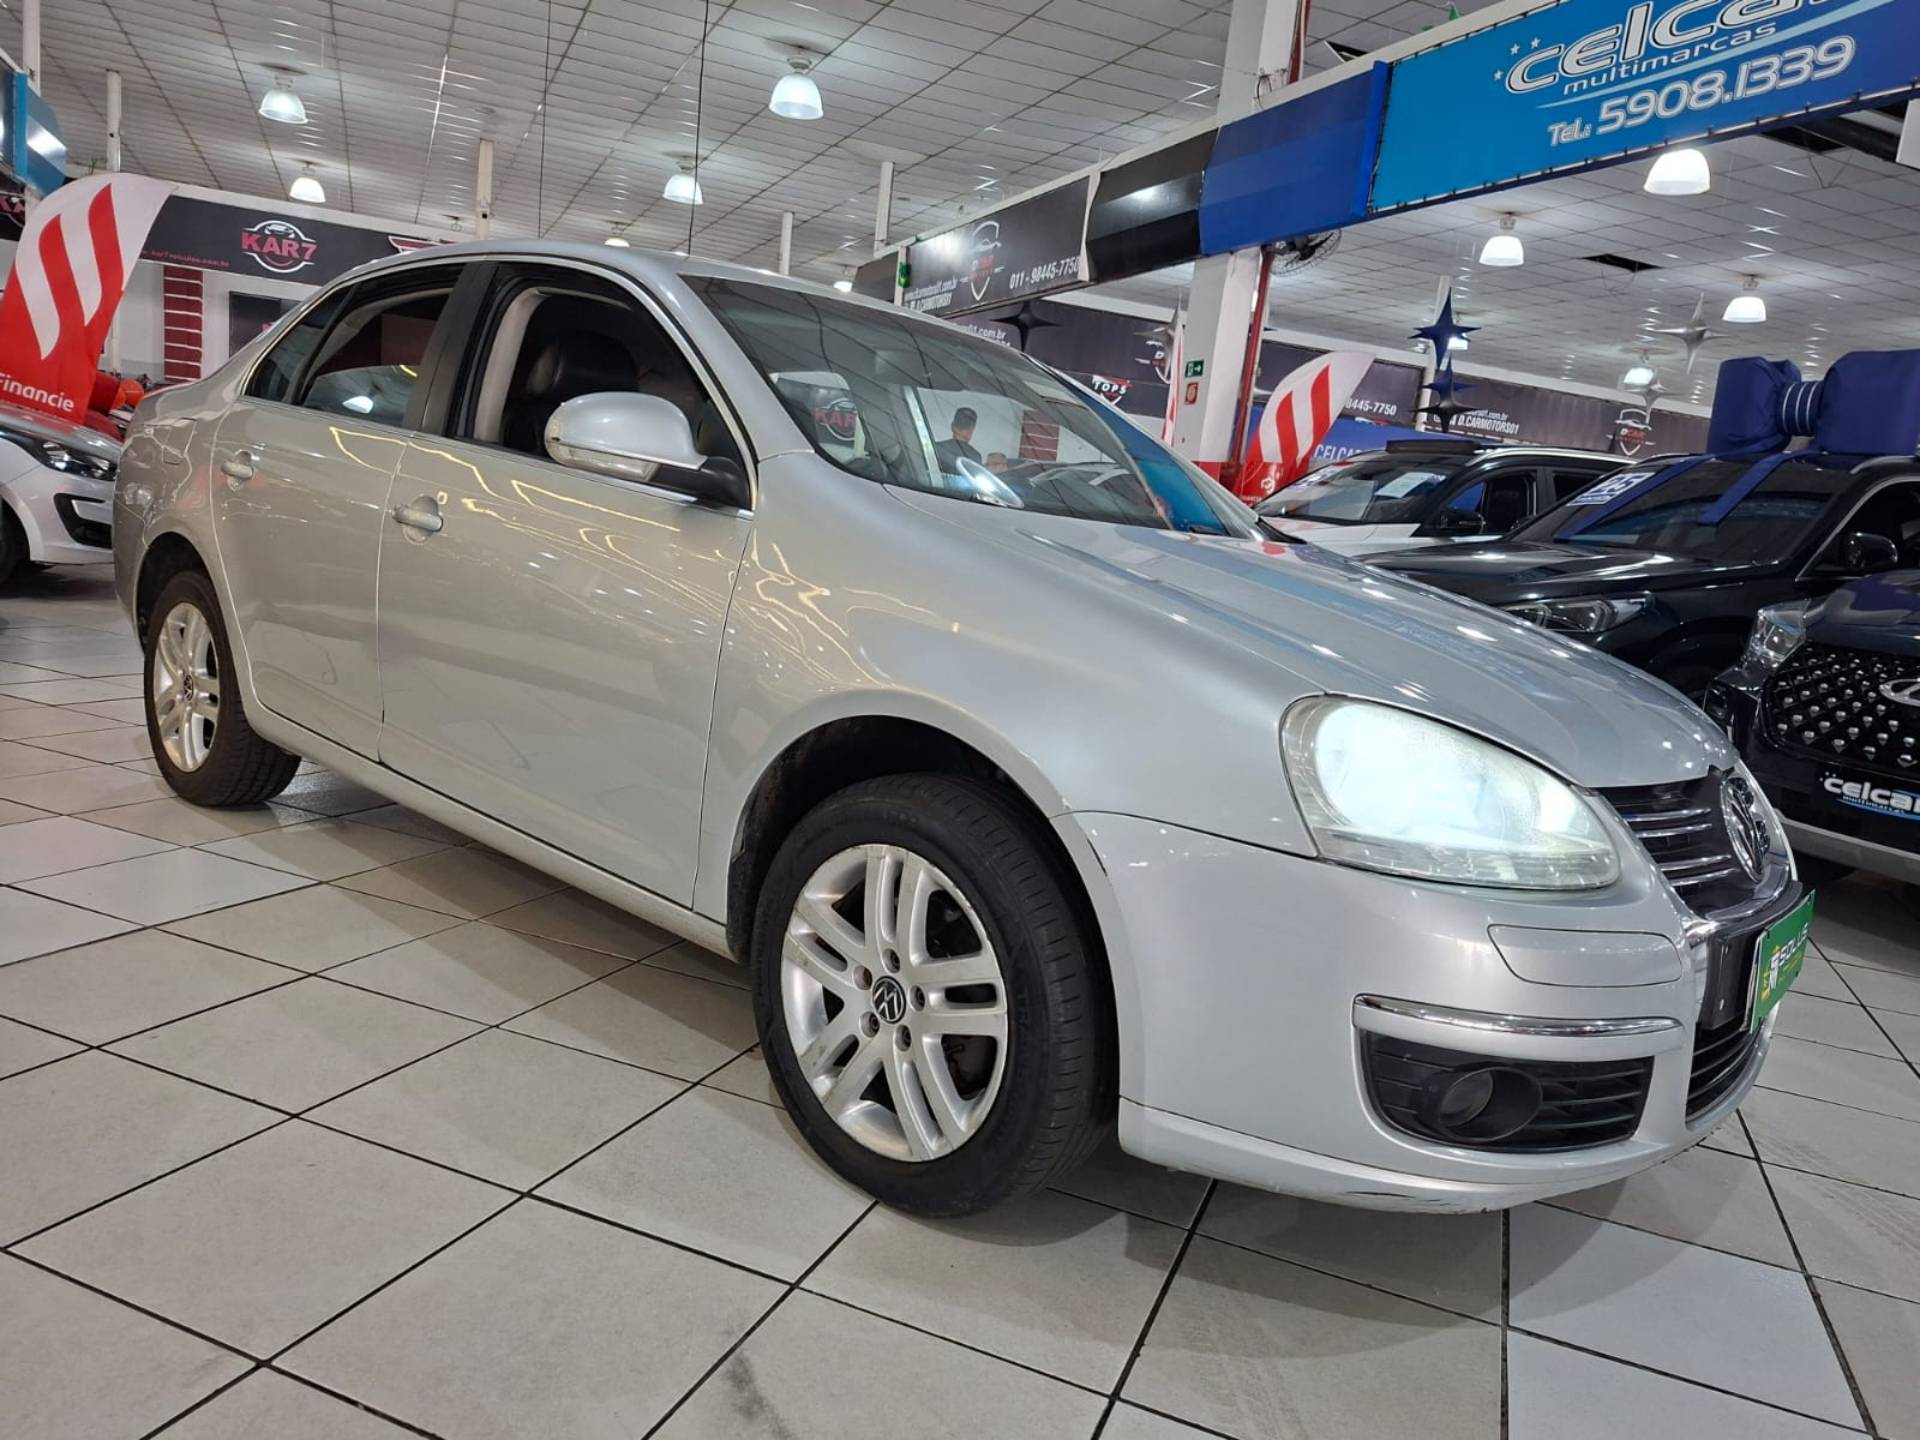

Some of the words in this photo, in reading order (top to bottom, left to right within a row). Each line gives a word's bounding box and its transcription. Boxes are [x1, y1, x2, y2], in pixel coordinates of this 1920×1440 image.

[1505, 0, 1825, 94] celca
[1563, 22, 1777, 97] multimarcas
[1596, 35, 1856, 135] 5908.1339
[240, 231, 317, 261] KAR7
[1009, 271, 1025, 289] 011
[1093, 381, 1127, 395] TOPS
